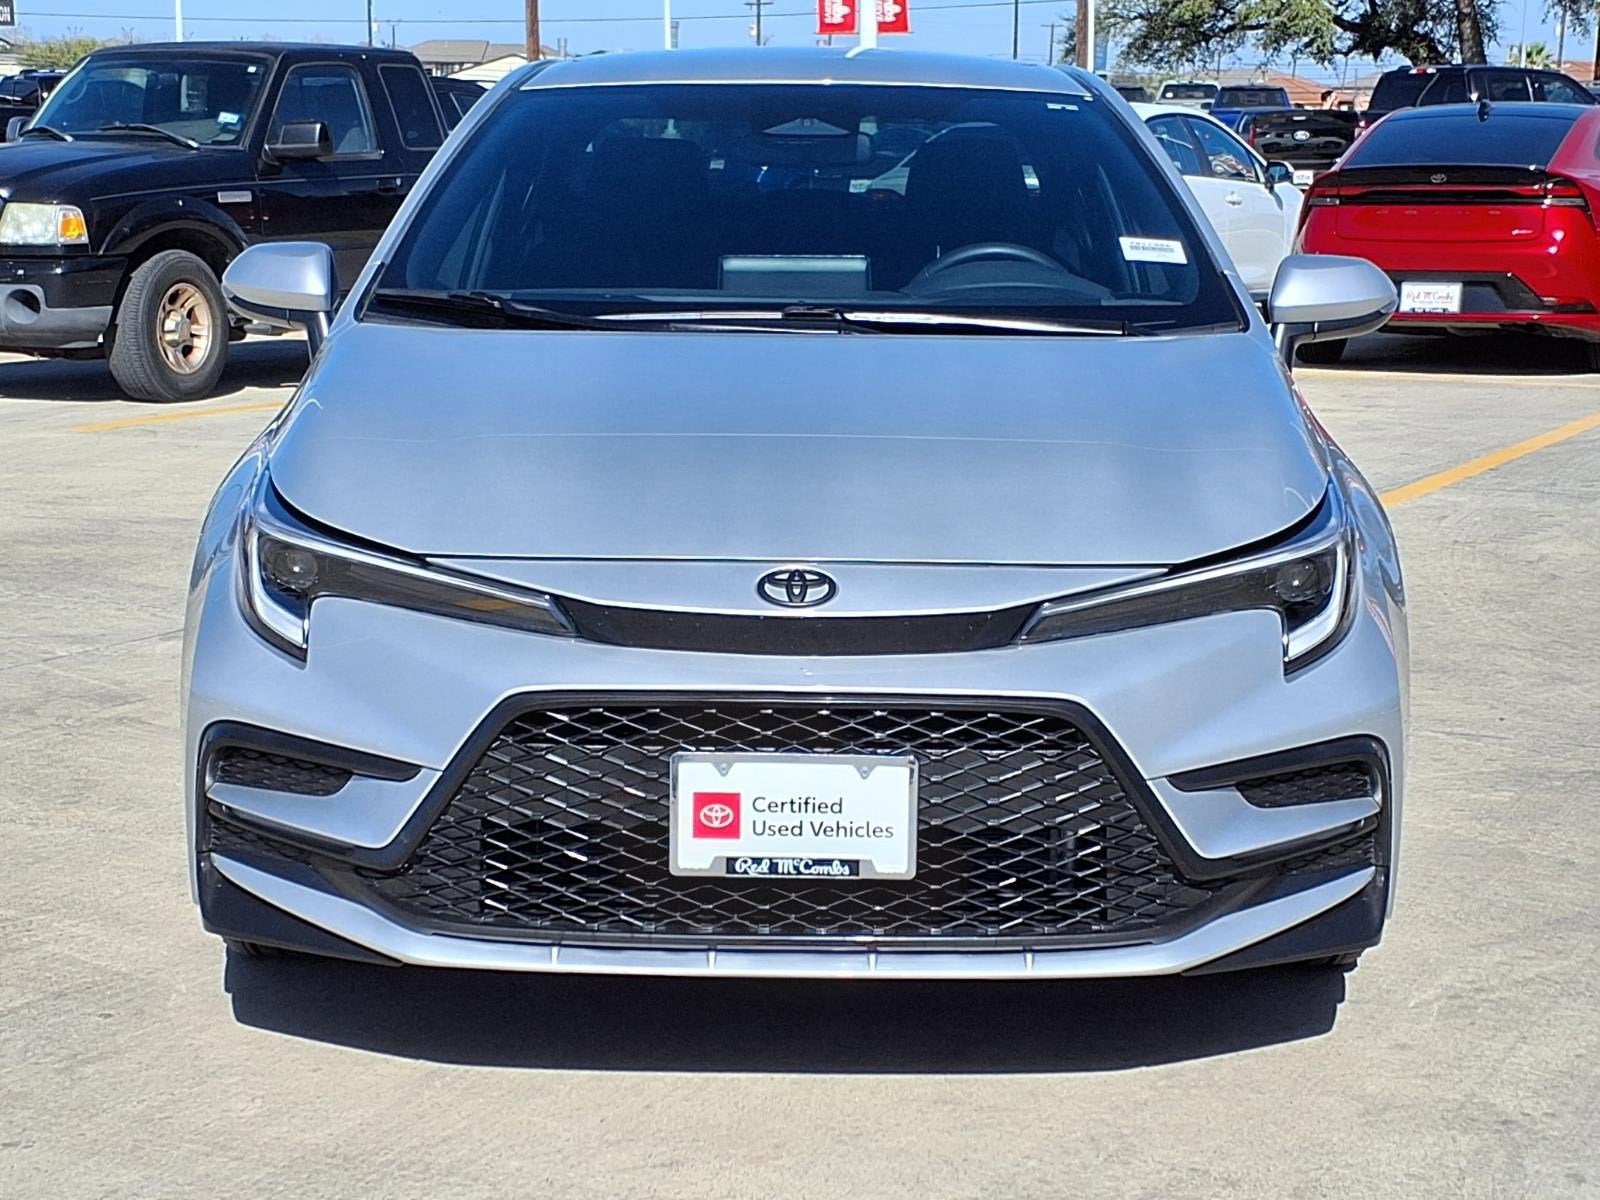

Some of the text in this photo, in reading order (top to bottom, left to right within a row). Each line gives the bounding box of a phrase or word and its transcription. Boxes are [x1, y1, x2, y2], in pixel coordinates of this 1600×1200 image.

[752, 796, 843, 814] Certified
[752, 820, 894, 838] Used Vehicles
[735, 857, 850, 876] Red McCombs
